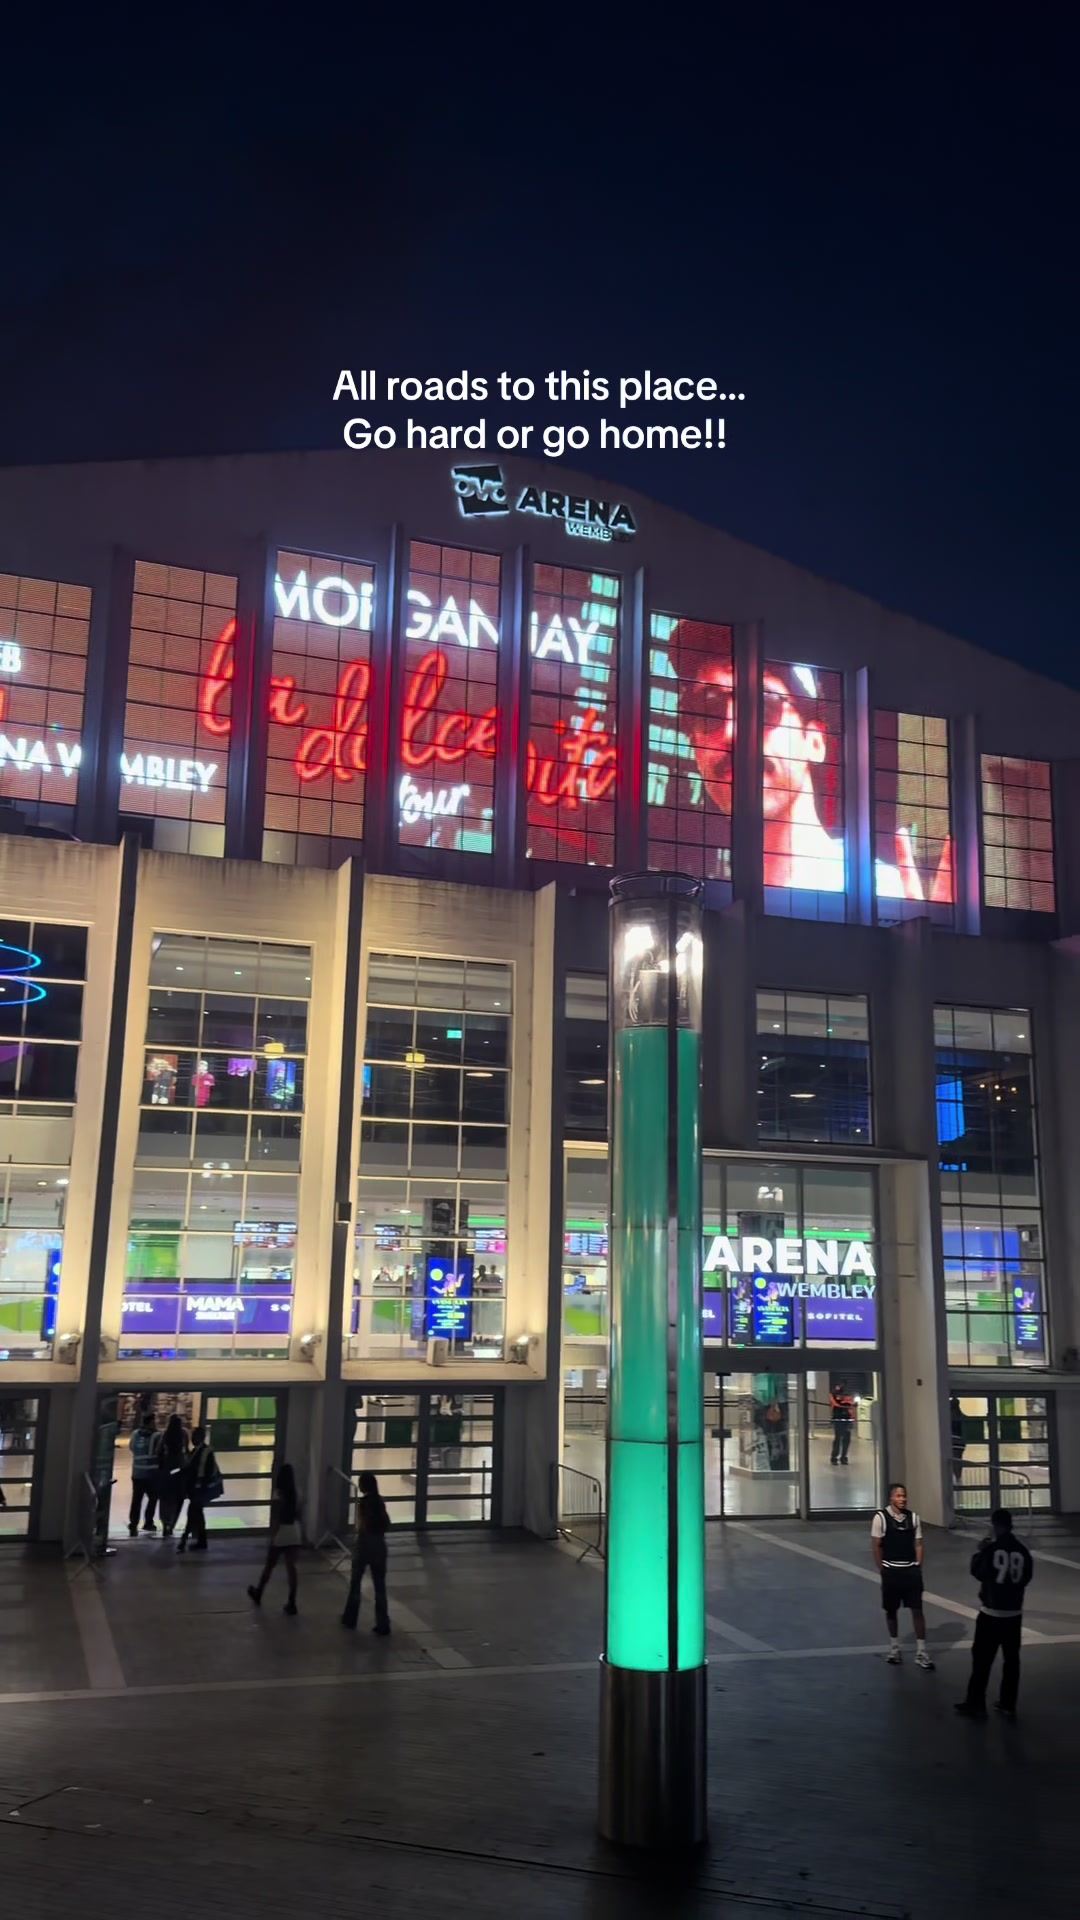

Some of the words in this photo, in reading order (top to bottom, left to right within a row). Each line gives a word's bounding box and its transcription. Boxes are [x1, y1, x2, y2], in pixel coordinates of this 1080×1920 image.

[516, 486, 636, 533] ARENA
[565, 521, 633, 543] WEMB
[703, 1235, 876, 1277] ARENA
[777, 1282, 876, 1299] WEMBLEY
[186, 1297, 245, 1312] MAMA
[807, 1312, 863, 1321] SOFITEL
